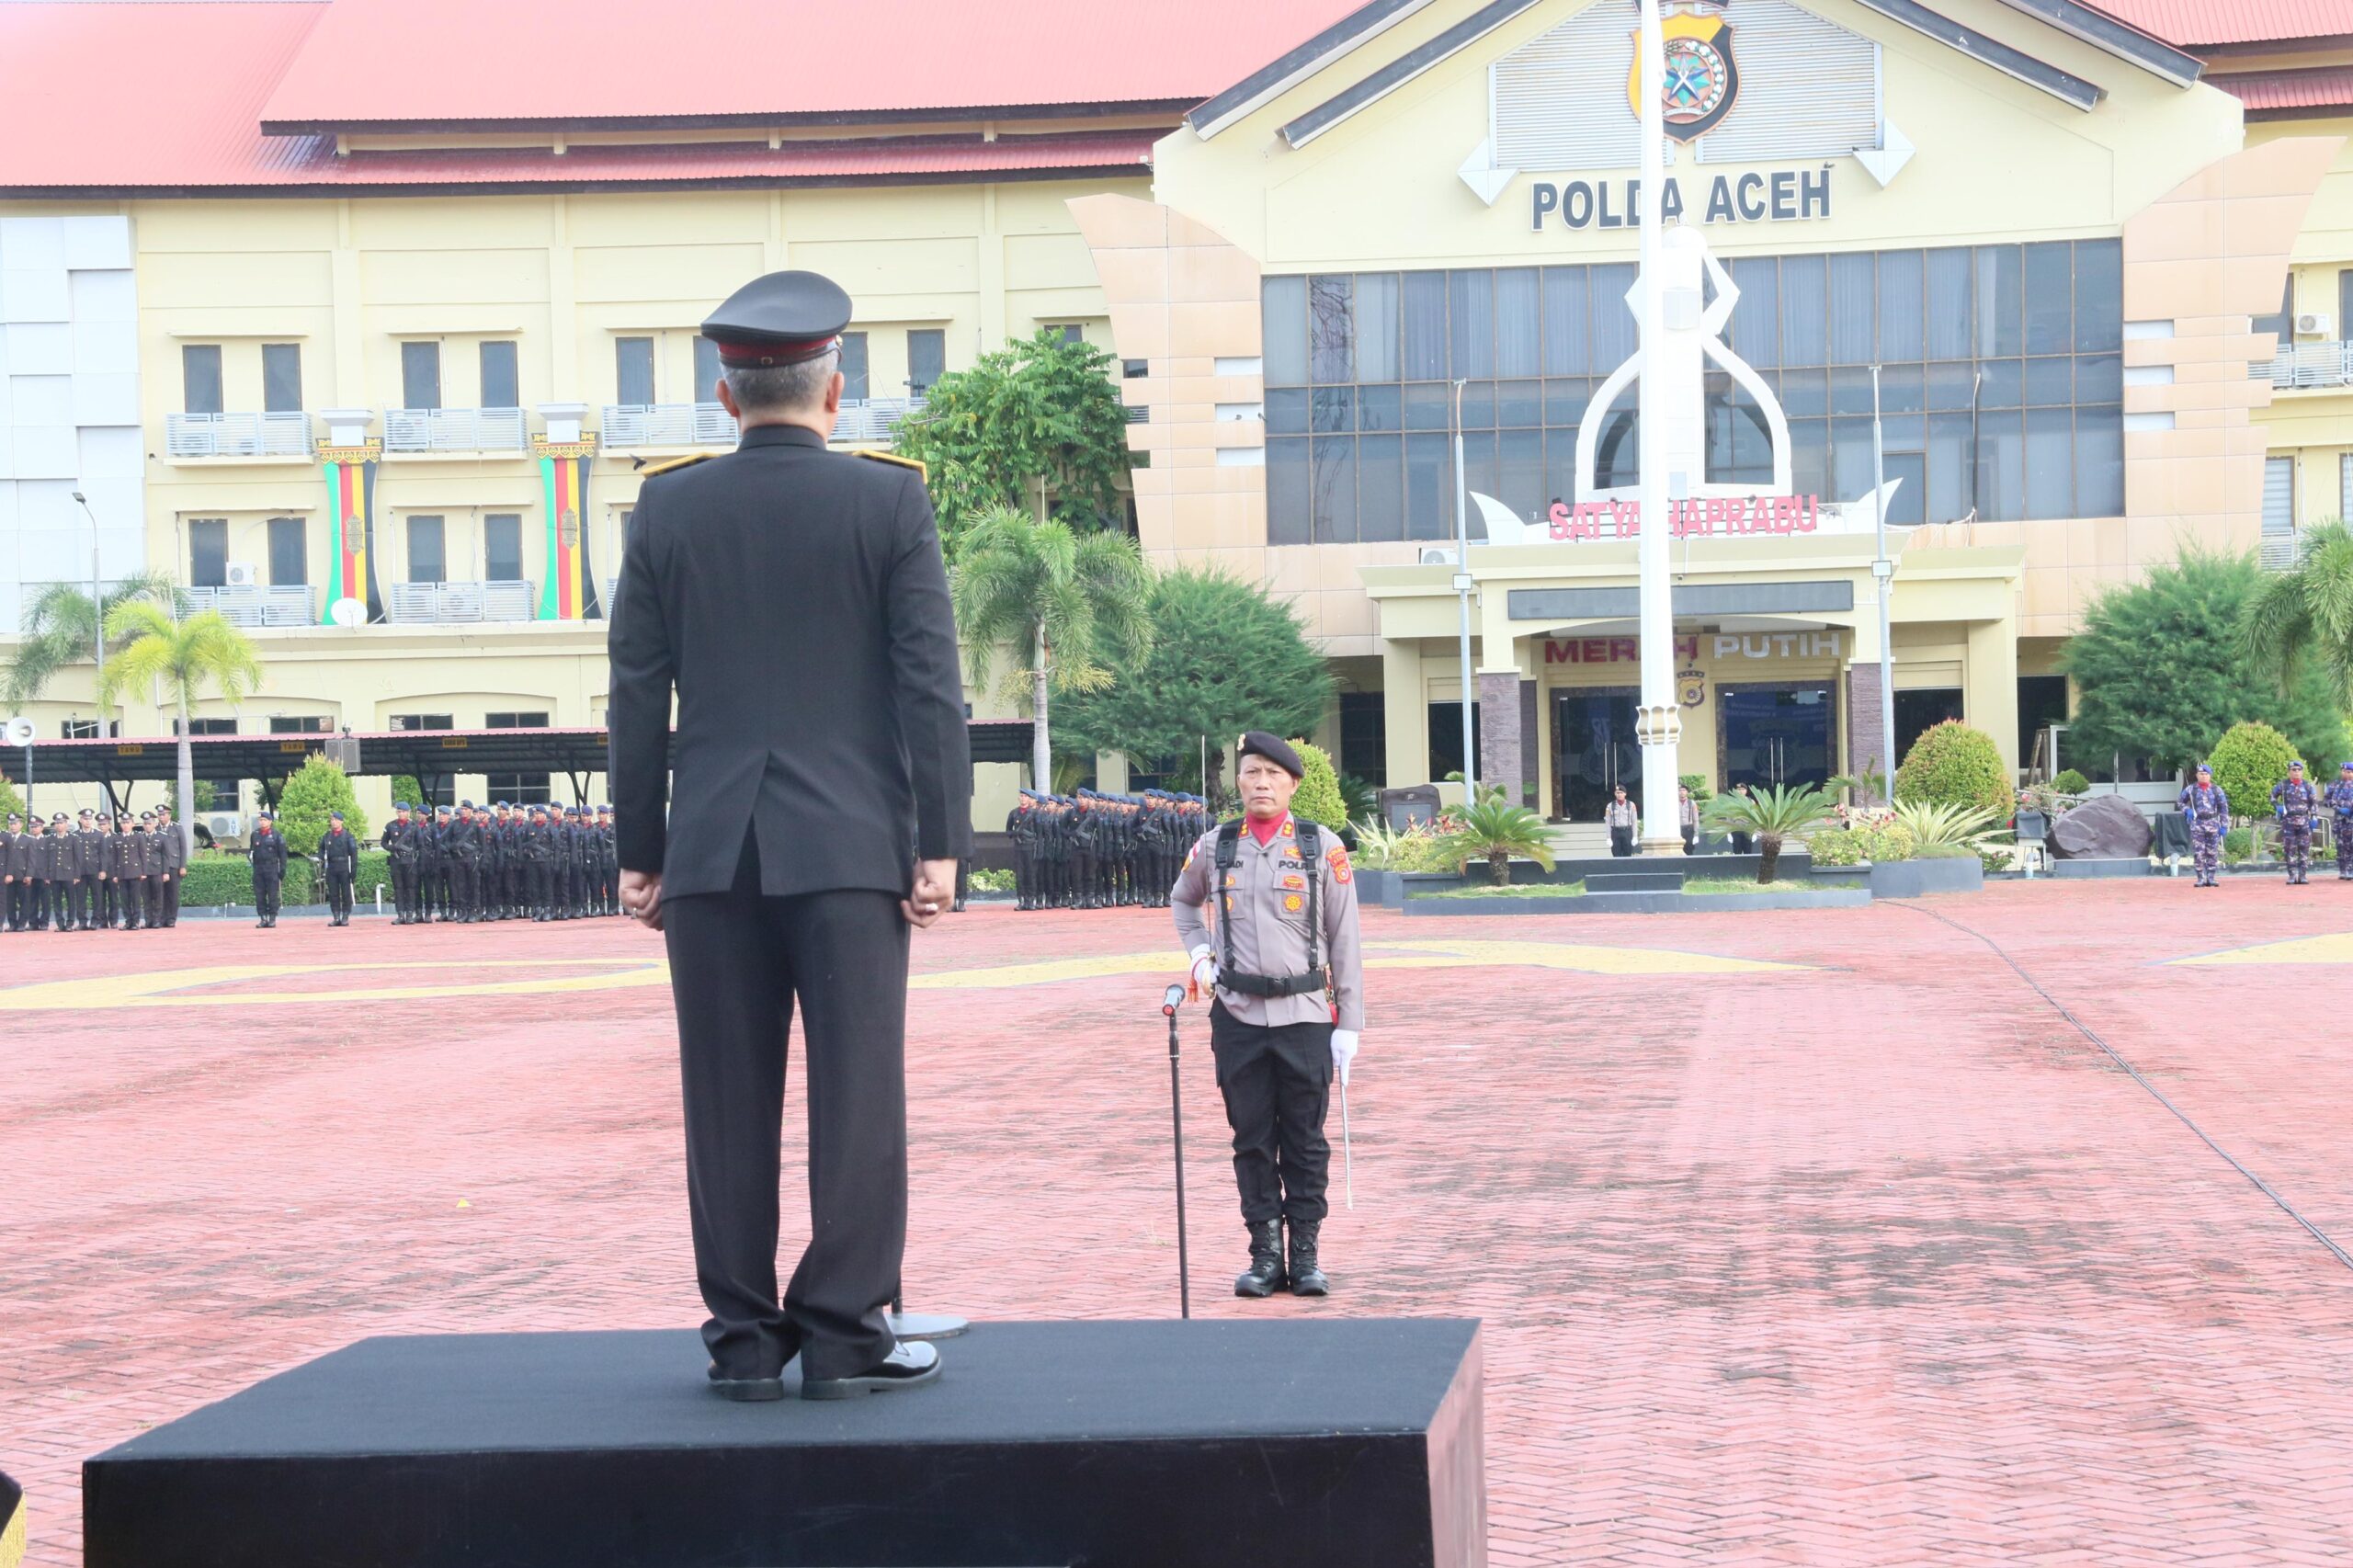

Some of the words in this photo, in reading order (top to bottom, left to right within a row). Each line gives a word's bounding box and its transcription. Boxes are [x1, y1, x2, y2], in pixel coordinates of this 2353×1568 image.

[1704, 168, 1830, 223] ACEH
[1550, 501, 1640, 540] SATYA
[1544, 635, 1699, 663] MERH
[1713, 633, 1839, 660] PUTIH
